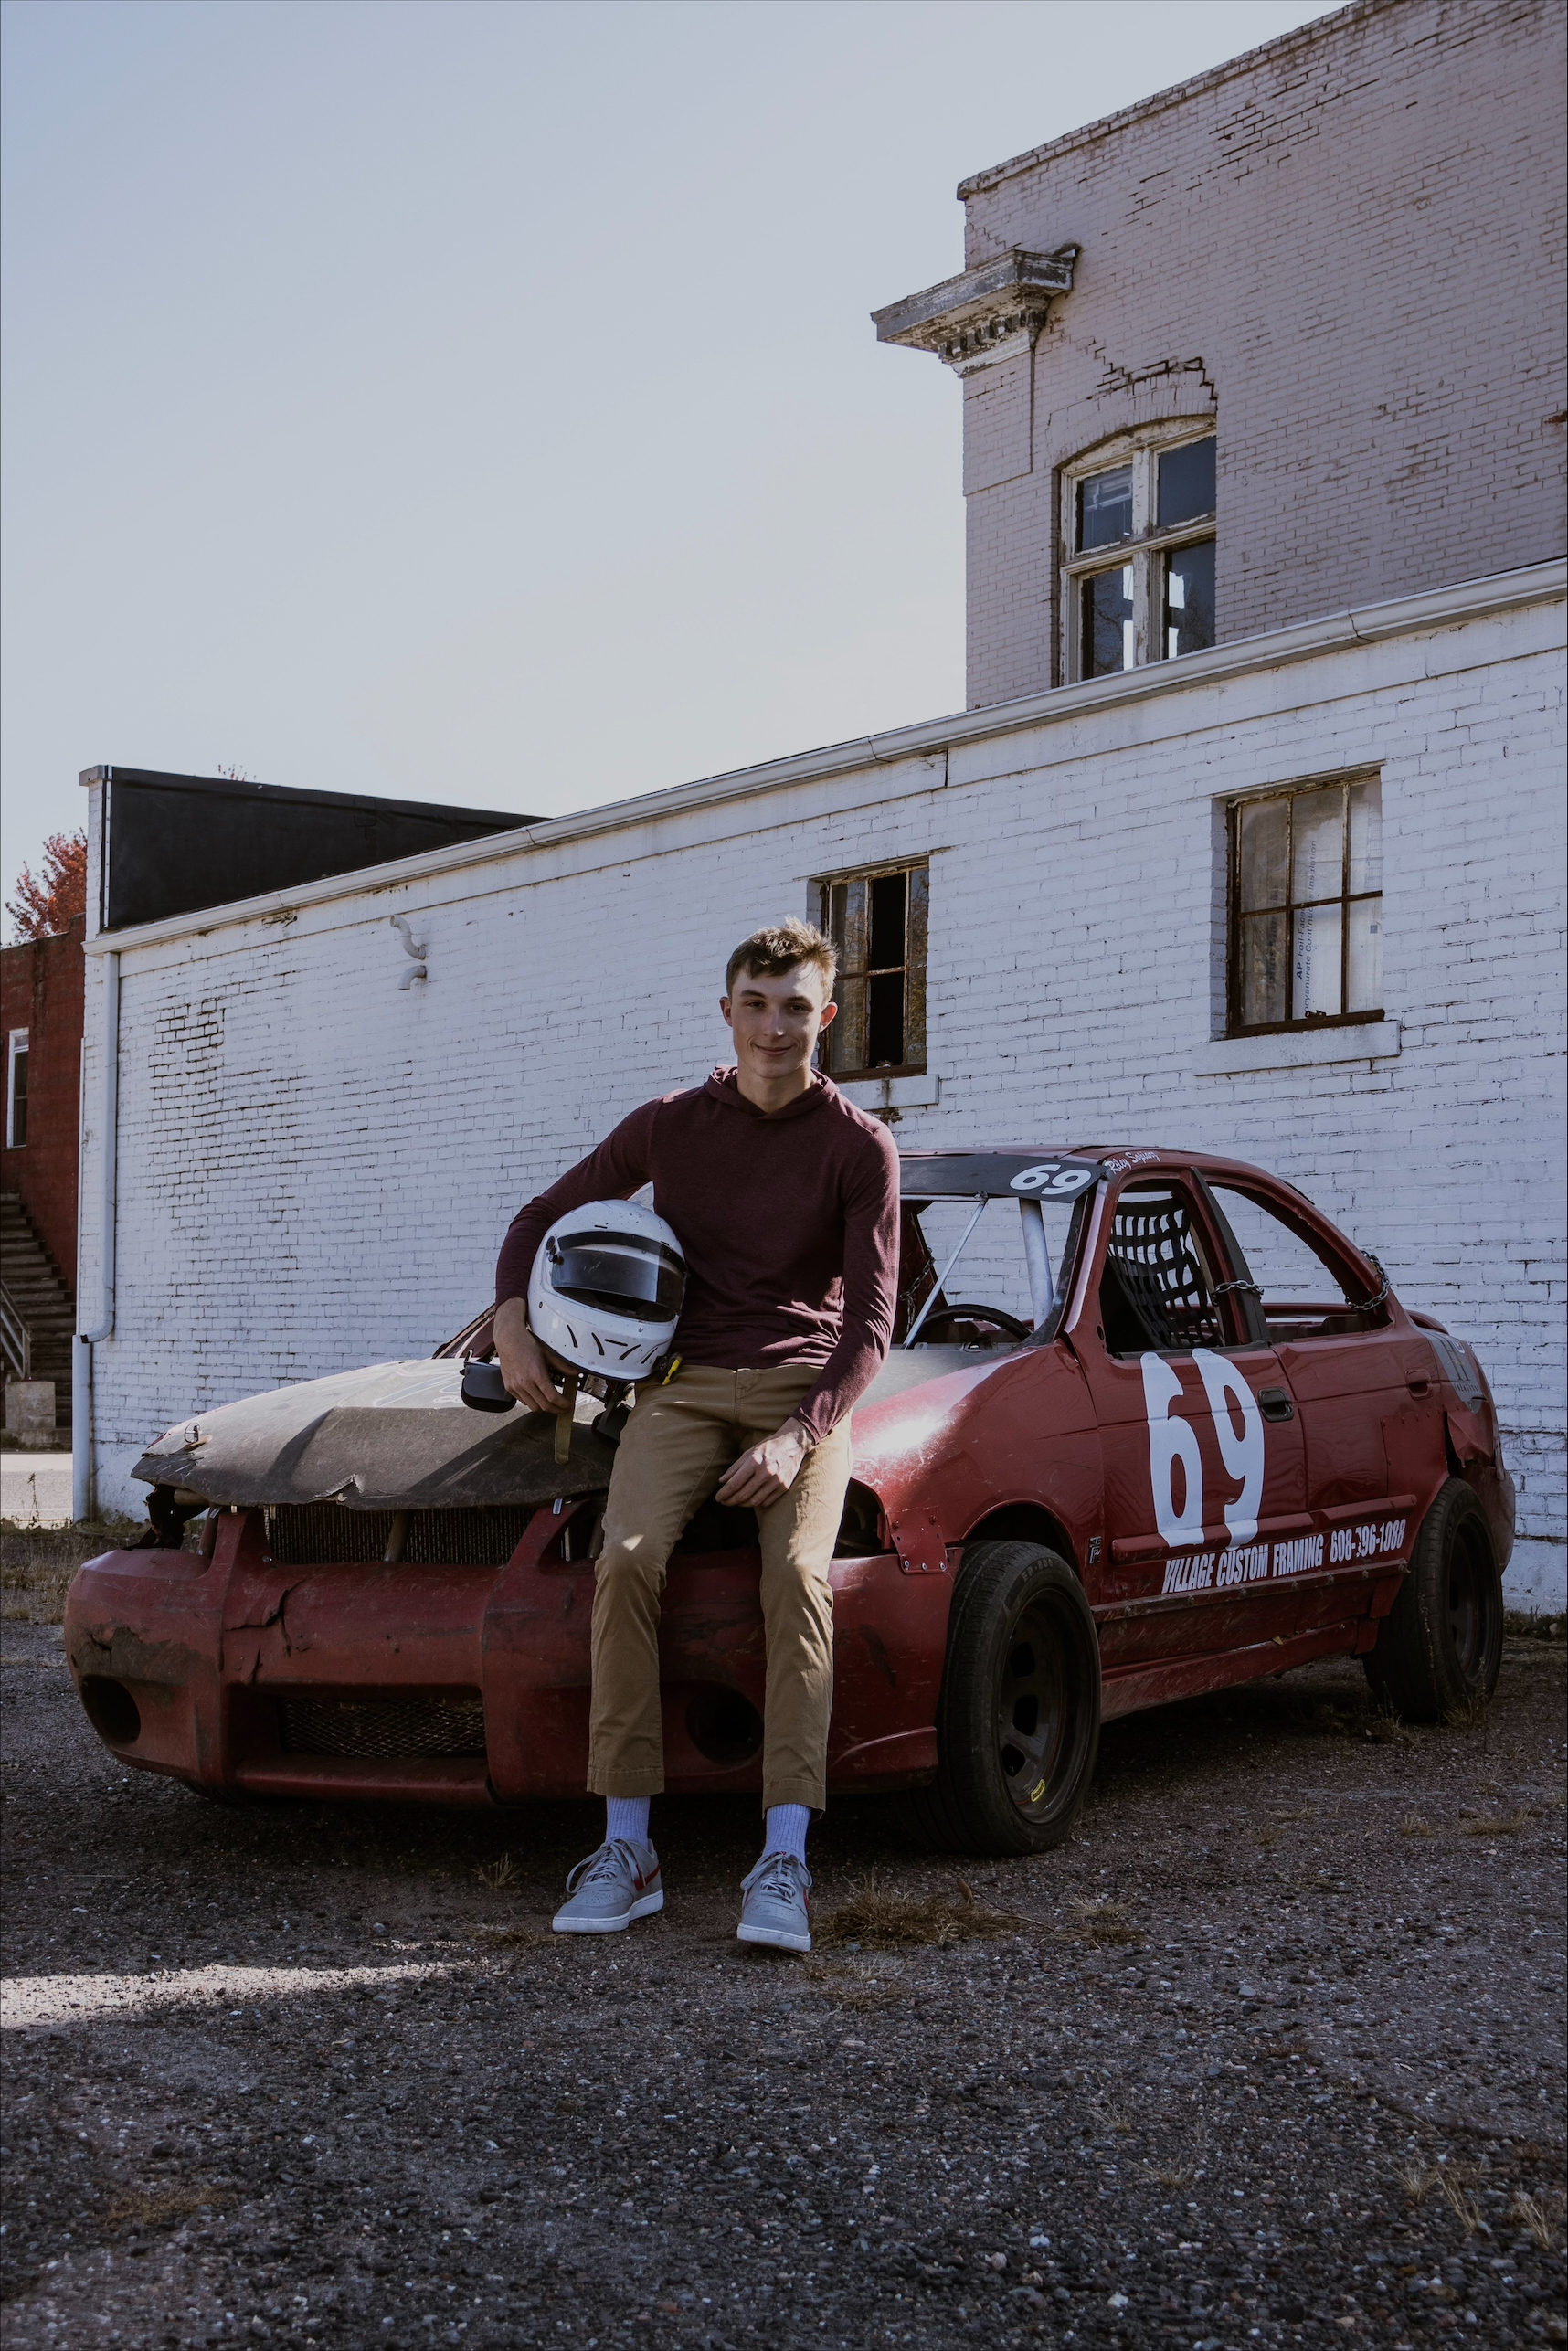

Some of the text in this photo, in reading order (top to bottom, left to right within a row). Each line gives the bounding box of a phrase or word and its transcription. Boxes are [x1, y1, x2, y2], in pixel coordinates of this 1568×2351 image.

[1308, 840, 1317, 890] Insulation
[1305, 894, 1314, 952] Continuos
[1010, 1164, 1092, 1194] 69
[1104, 1158, 1131, 1174] Riley
[1140, 1348, 1265, 1551] 69
[1161, 1519, 1406, 1594] VILLAGE CUSTOM FRAMING 608-796-1088
